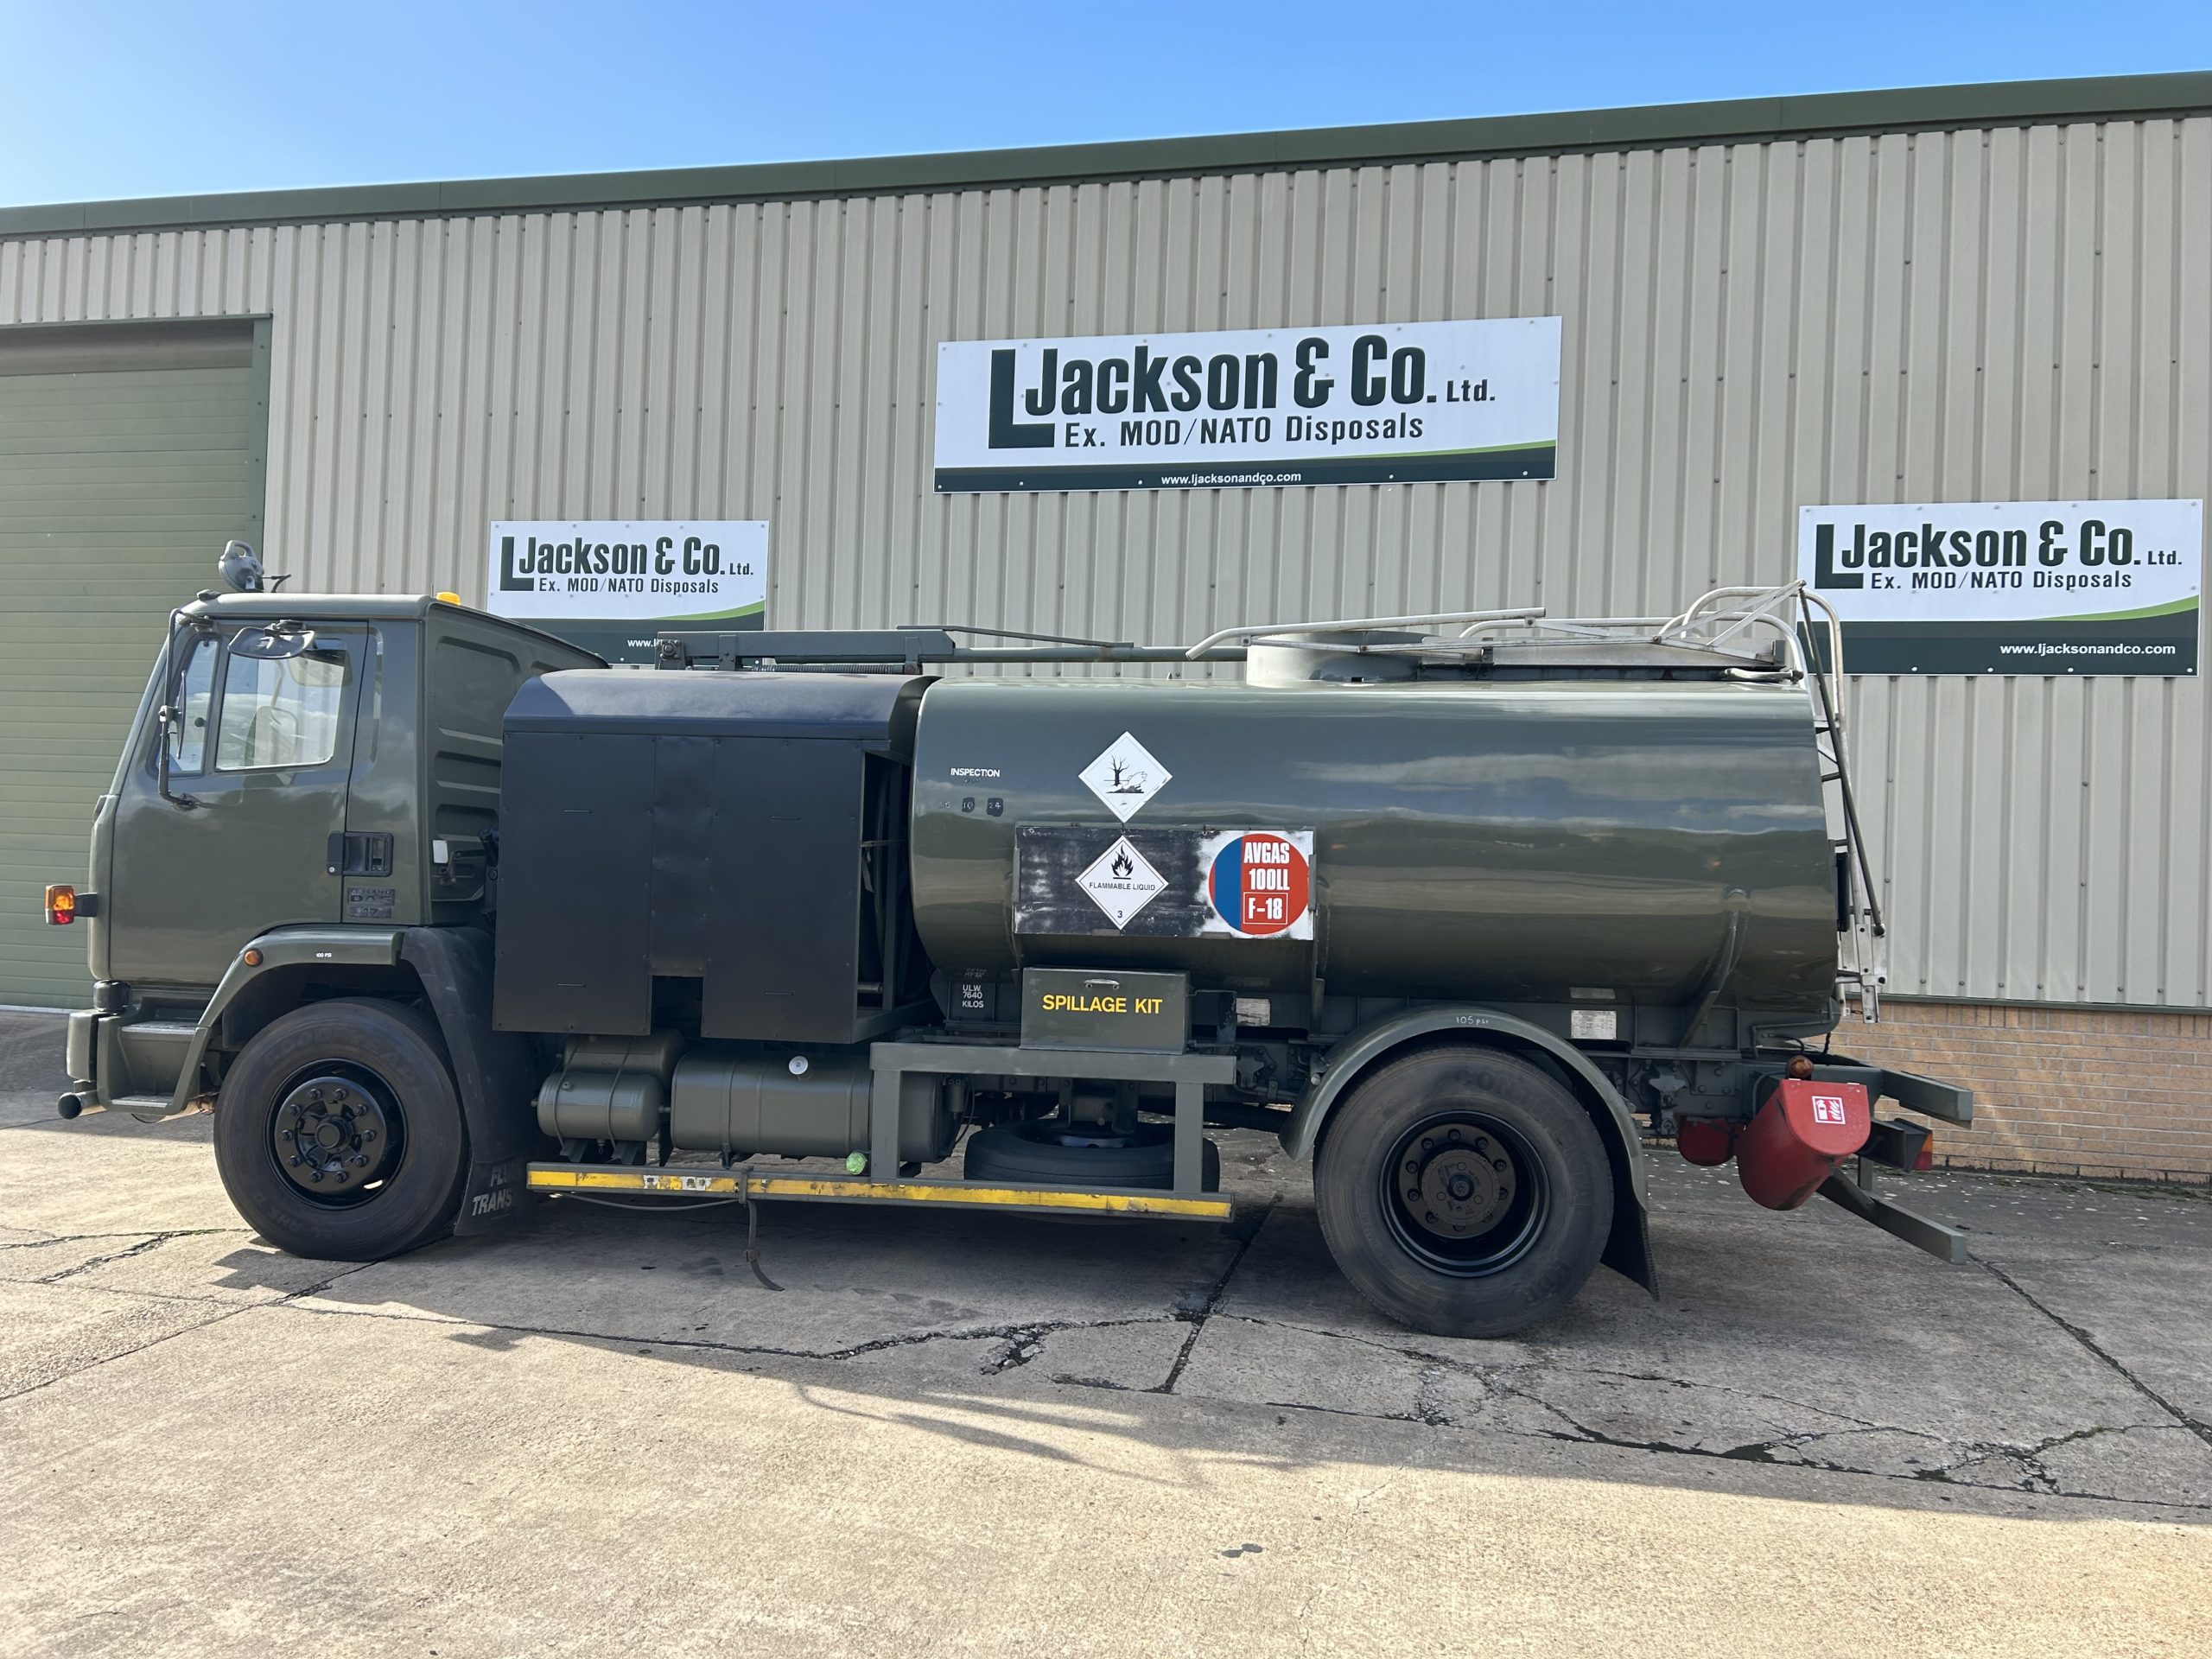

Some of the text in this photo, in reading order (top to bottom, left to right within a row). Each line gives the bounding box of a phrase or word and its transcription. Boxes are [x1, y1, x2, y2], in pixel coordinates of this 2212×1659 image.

[1294, 337, 1334, 408] &
[1351, 334, 1437, 406] Co.
[1446, 378, 1496, 403] Ltd.
[1065, 412, 1423, 448] Ex. MOD/NATO Disposals
[1161, 472, 1301, 486] www.ljacksonandco.com
[2039, 520, 2068, 566] &
[2080, 519, 2140, 566] Co.
[2147, 550, 2182, 566] Ltd.
[655, 537, 675, 575] &
[683, 537, 725, 575] Co.
[729, 563, 753, 575] Ltd.
[539, 578, 719, 594] Ex. MOD/NATO Disposals
[1871, 570, 2132, 591] Ex. MOD/NATO Disposals
[1999, 643, 2176, 658] www.ljacksonandco.com
[950, 767, 1001, 778] INSPECTION
[1244, 842, 1291, 865] AVGAS
[1089, 880, 1156, 892] FLAMMABLE LIQUID
[1249, 868, 1291, 891] 100LL
[1116, 910, 1123, 918] 3
[1248, 897, 1284, 920] F-18
[962, 1000, 984, 1008] KILOS
[1042, 995, 1162, 1014] SPILLAGE KIT
[1456, 1015, 1474, 1026] 105
